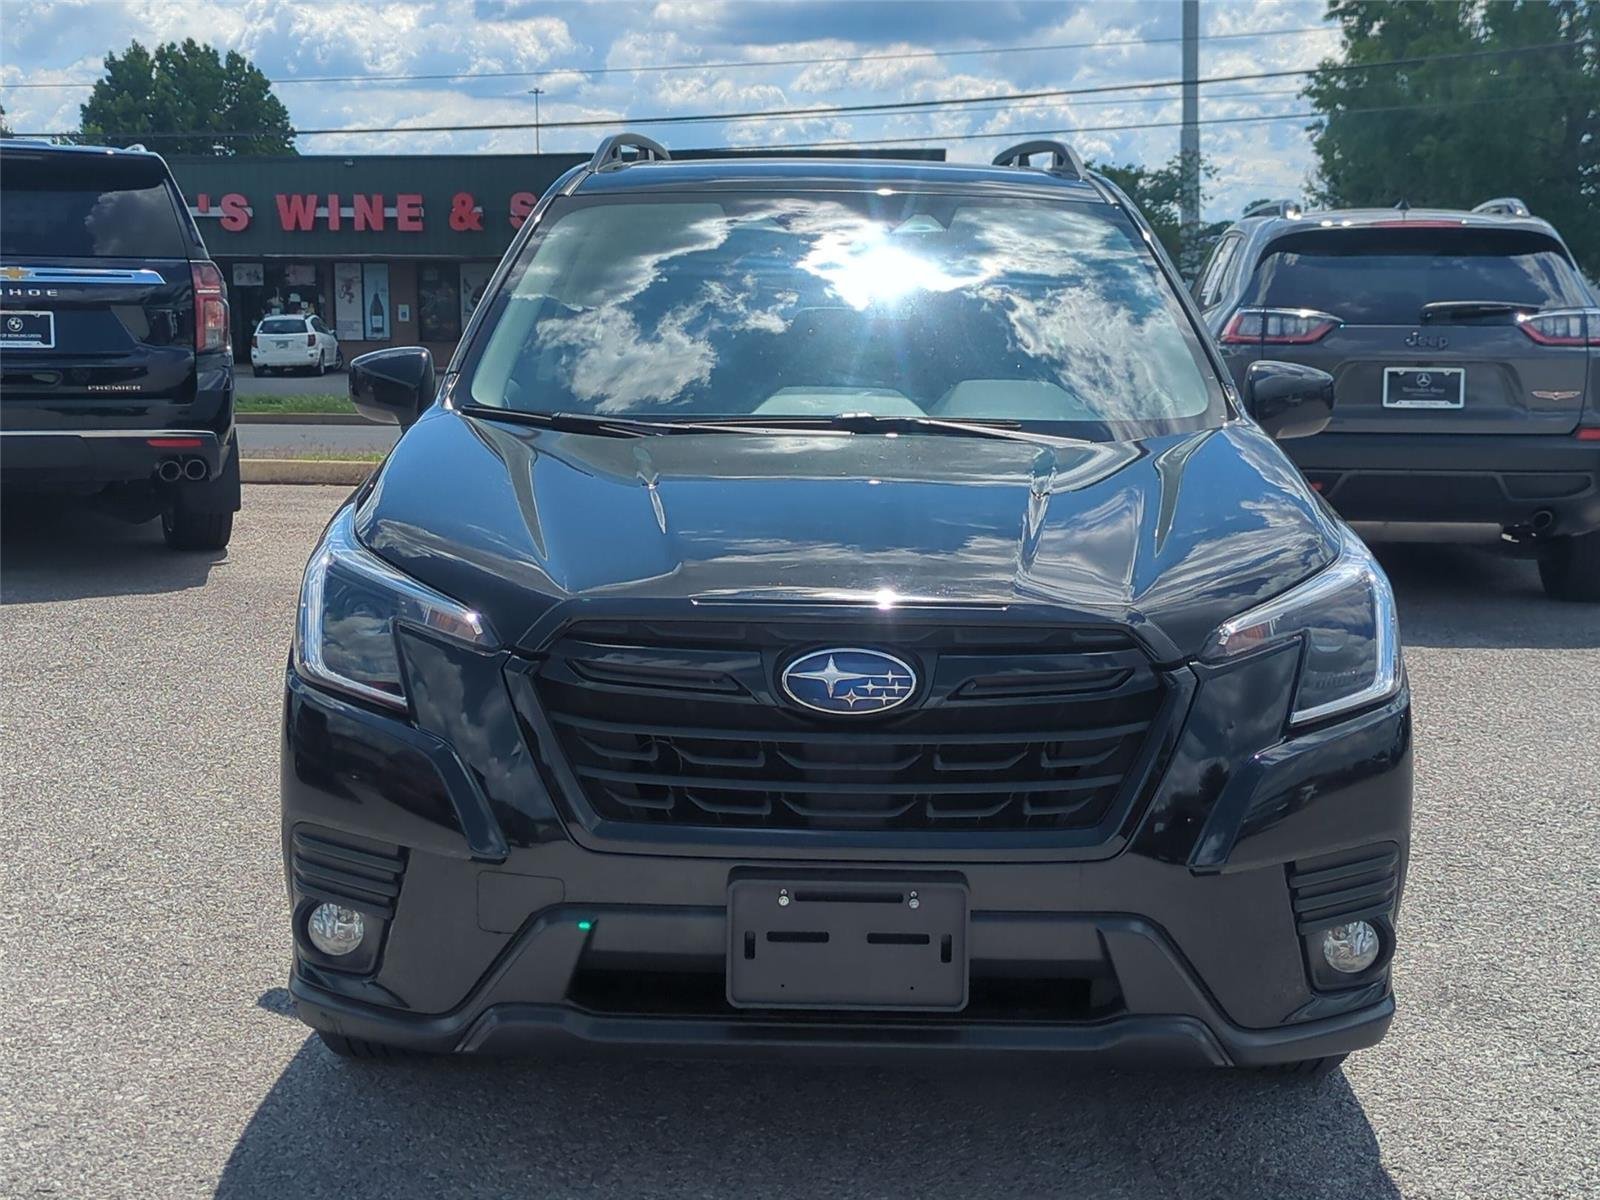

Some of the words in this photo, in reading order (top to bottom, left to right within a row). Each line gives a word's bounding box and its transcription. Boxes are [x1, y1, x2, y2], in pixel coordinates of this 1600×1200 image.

[197, 193, 250, 232] 'S
[276, 193, 423, 232] WINE
[450, 191, 484, 232] &
[509, 191, 539, 231] S
[0, 288, 58, 297] HOE
[1404, 331, 1449, 350] Jeep
